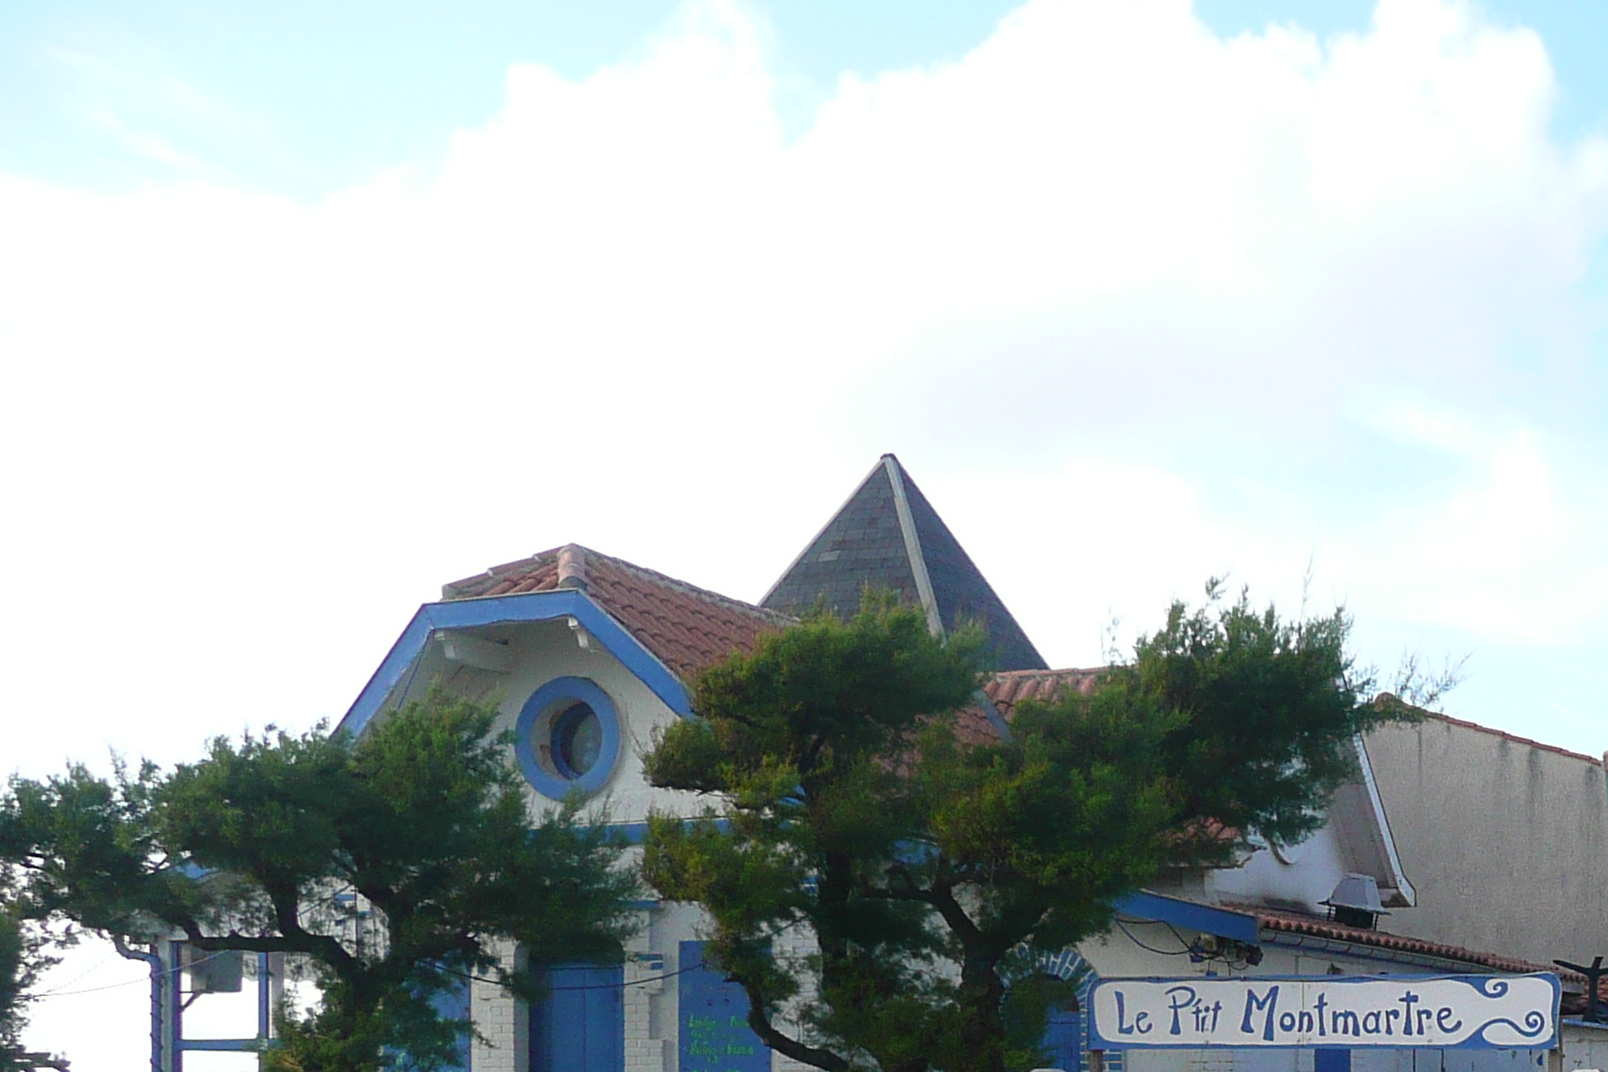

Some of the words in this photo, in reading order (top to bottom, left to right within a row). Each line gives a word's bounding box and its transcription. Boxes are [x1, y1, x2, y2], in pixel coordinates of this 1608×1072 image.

[1113, 990, 1153, 1035] Le
[1164, 985, 1222, 1035] P'tit
[1240, 984, 1463, 1042] Montmartre
